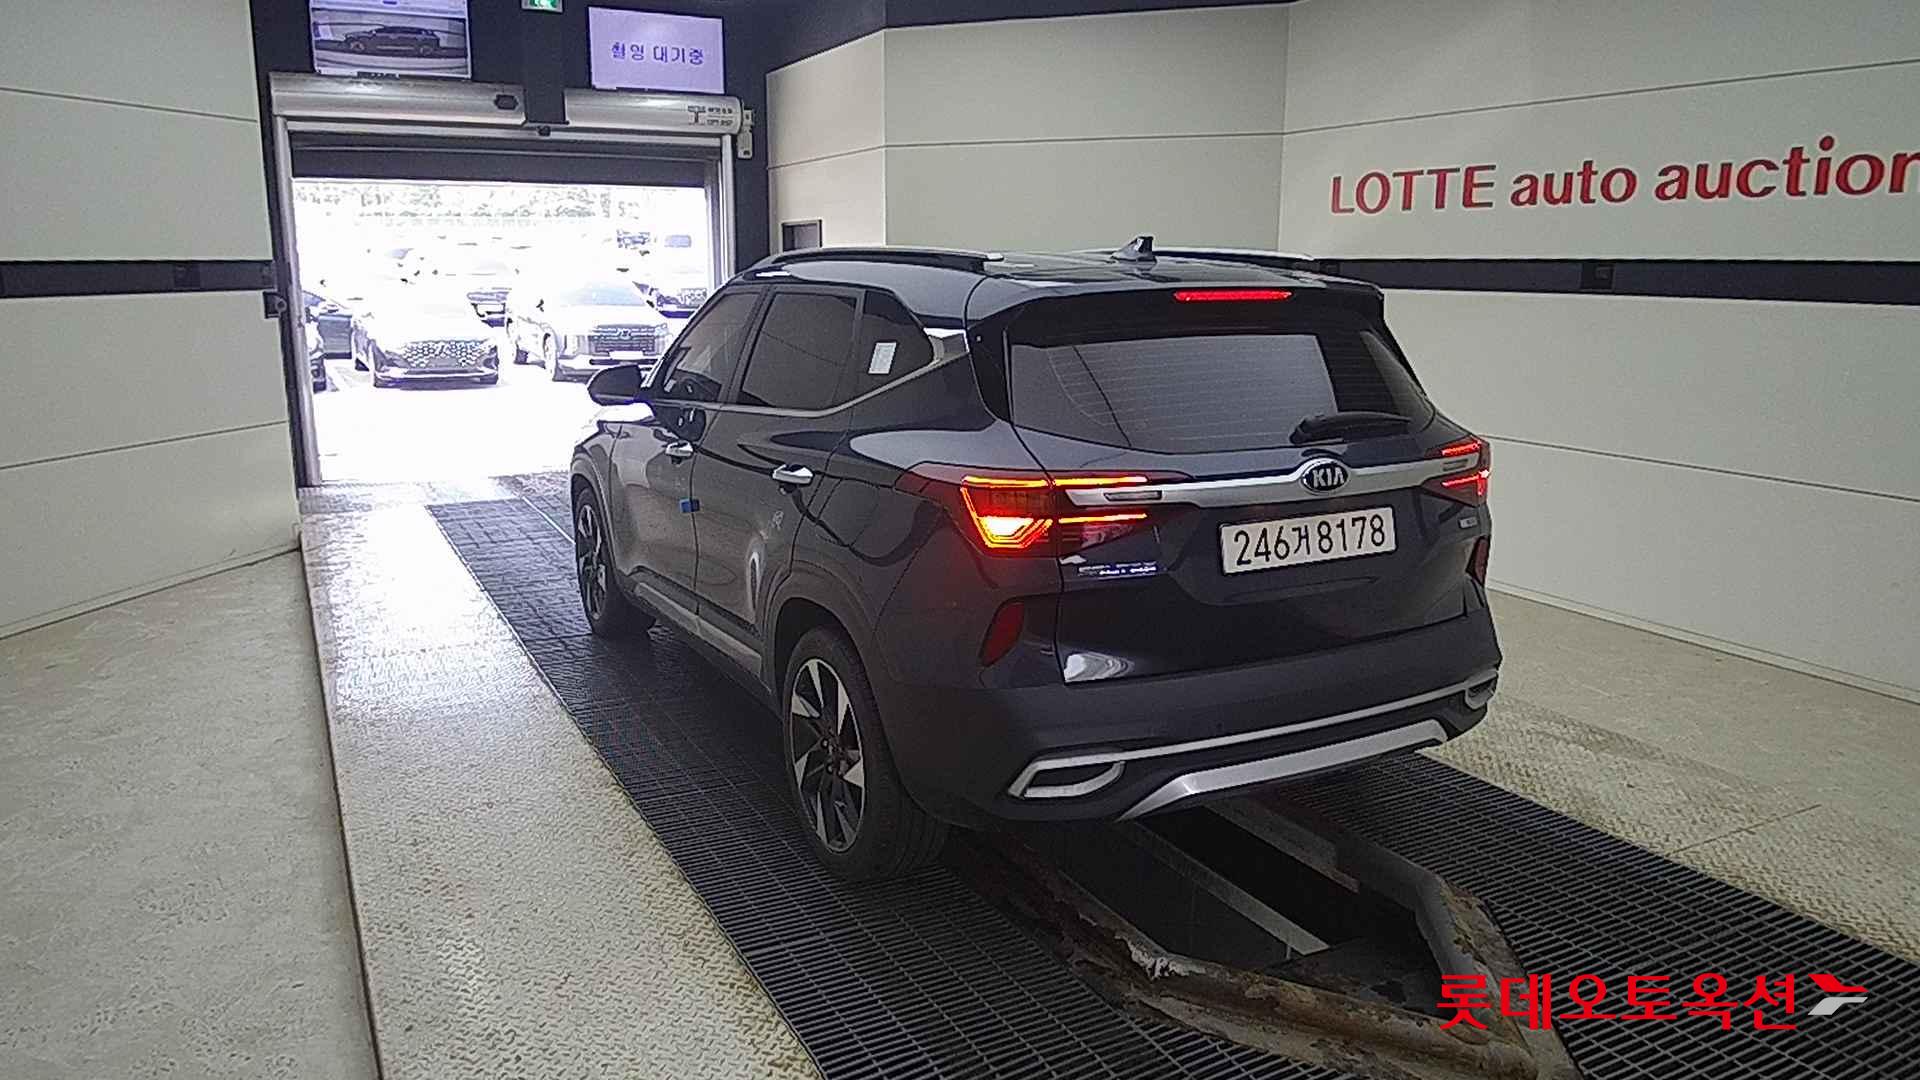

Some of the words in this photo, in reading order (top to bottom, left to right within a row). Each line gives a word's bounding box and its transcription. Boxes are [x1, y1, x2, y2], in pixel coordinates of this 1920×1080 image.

[653, 45, 704, 65] 대기중
[1331, 164, 1497, 215] LOTTE
[1510, 160, 1637, 208] auto
[1312, 466, 1345, 488] KIA
[1233, 513, 1386, 566] 246거8178
